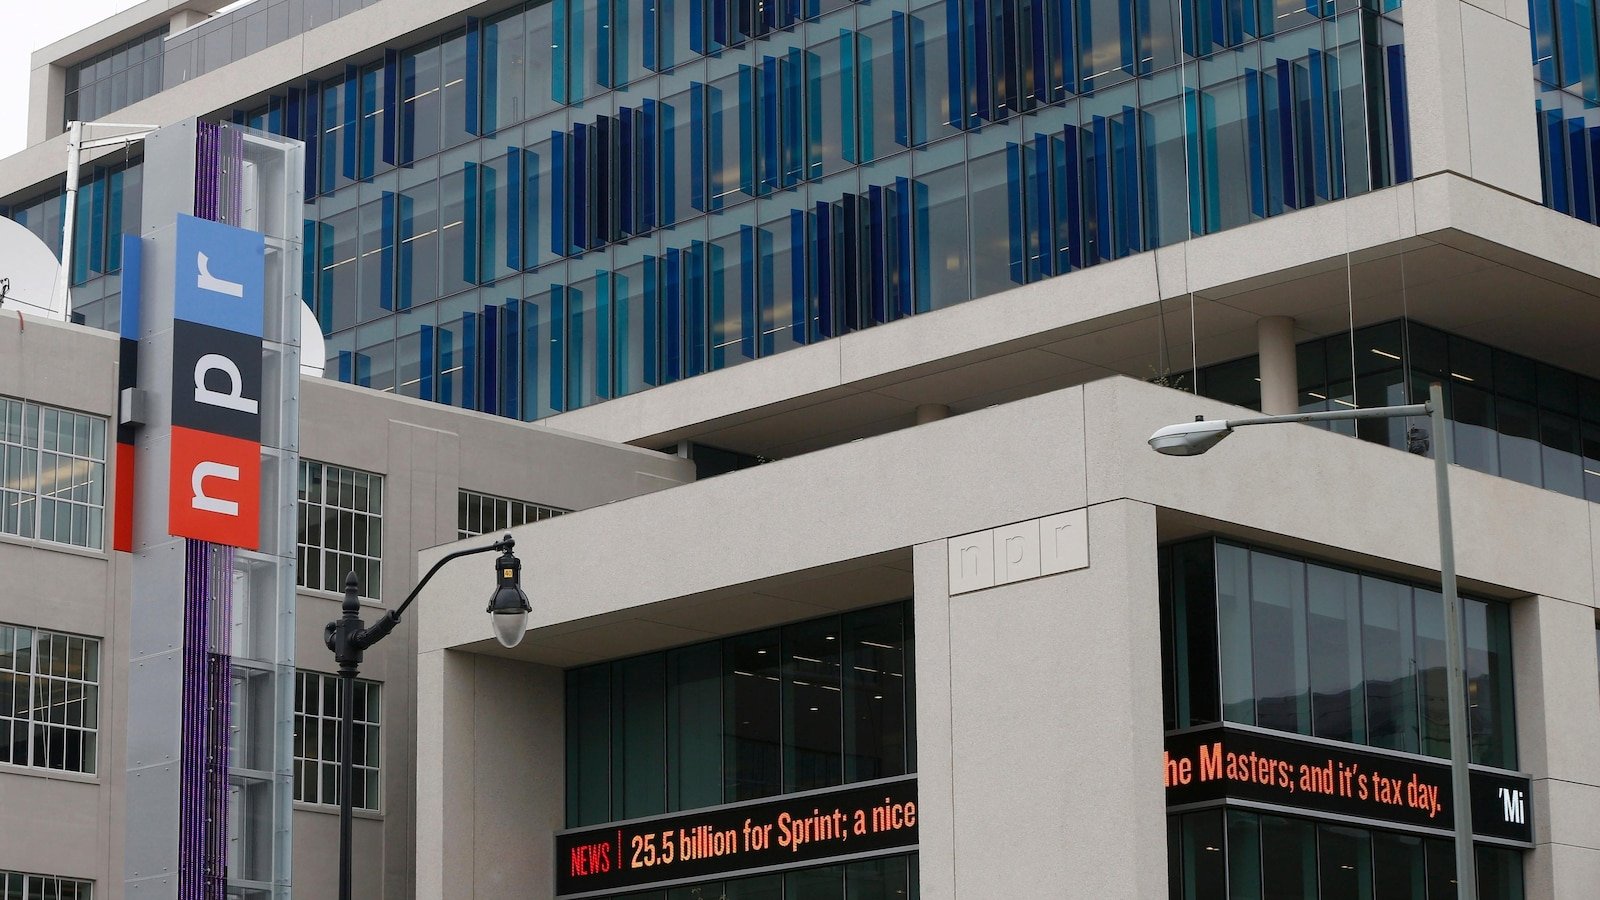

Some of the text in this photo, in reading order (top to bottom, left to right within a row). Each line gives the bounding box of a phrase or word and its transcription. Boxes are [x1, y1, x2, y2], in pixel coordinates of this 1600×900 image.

[192, 251, 258, 516] npr
[960, 524, 1074, 581] npr
[1200, 742, 1295, 792] Masters;
[1300, 760, 1333, 794] and
[1339, 762, 1368, 800] it's
[1372, 772, 1402, 805] tax
[1408, 774, 1441, 817] day.
[572, 798, 915, 876] NEWS 25.5 billion for Sprint; a nice
